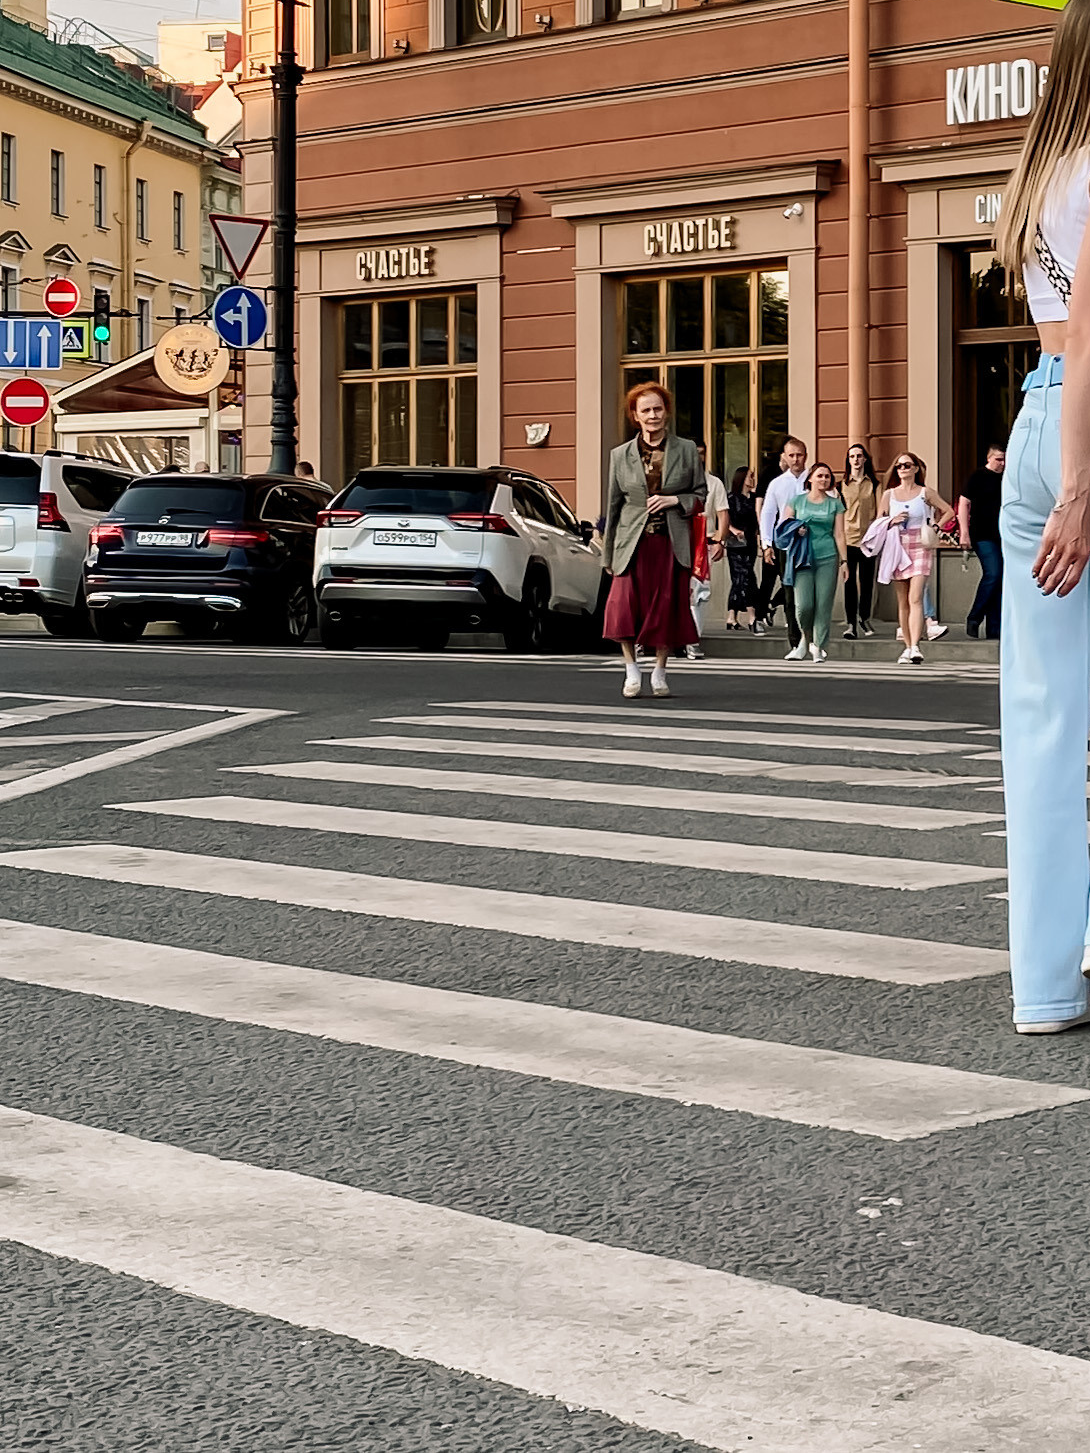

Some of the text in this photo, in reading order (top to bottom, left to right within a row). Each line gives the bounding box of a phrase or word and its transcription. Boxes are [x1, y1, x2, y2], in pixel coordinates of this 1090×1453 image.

[945, 58, 1037, 126] КИНО
[975, 193, 1001, 224] CIN
[644, 215, 732, 255] СЧАСТЬЕ
[356, 245, 431, 281] СЧАСТЬЕ
